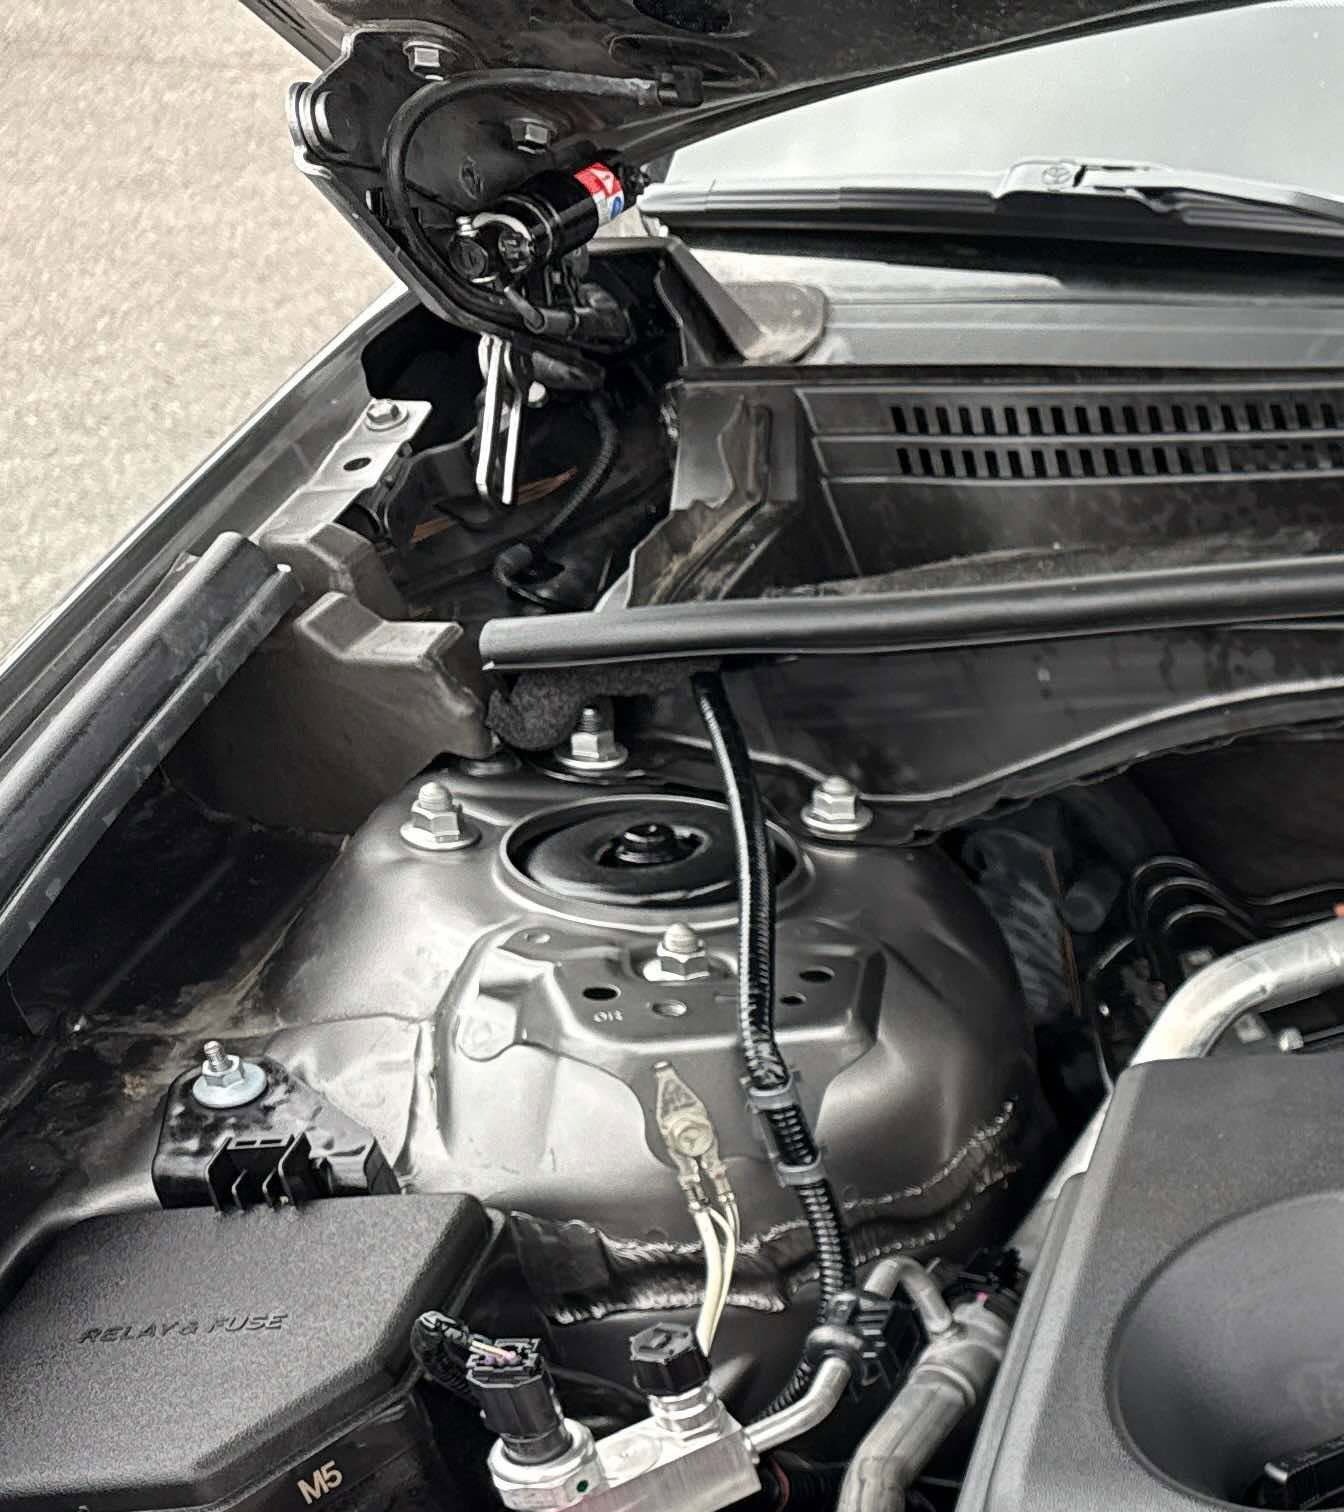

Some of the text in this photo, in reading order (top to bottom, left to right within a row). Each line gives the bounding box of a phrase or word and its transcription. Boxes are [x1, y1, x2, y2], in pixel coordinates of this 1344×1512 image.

[77, 1312, 289, 1344] RELAY & FUSE
[296, 1460, 344, 1504] M5
